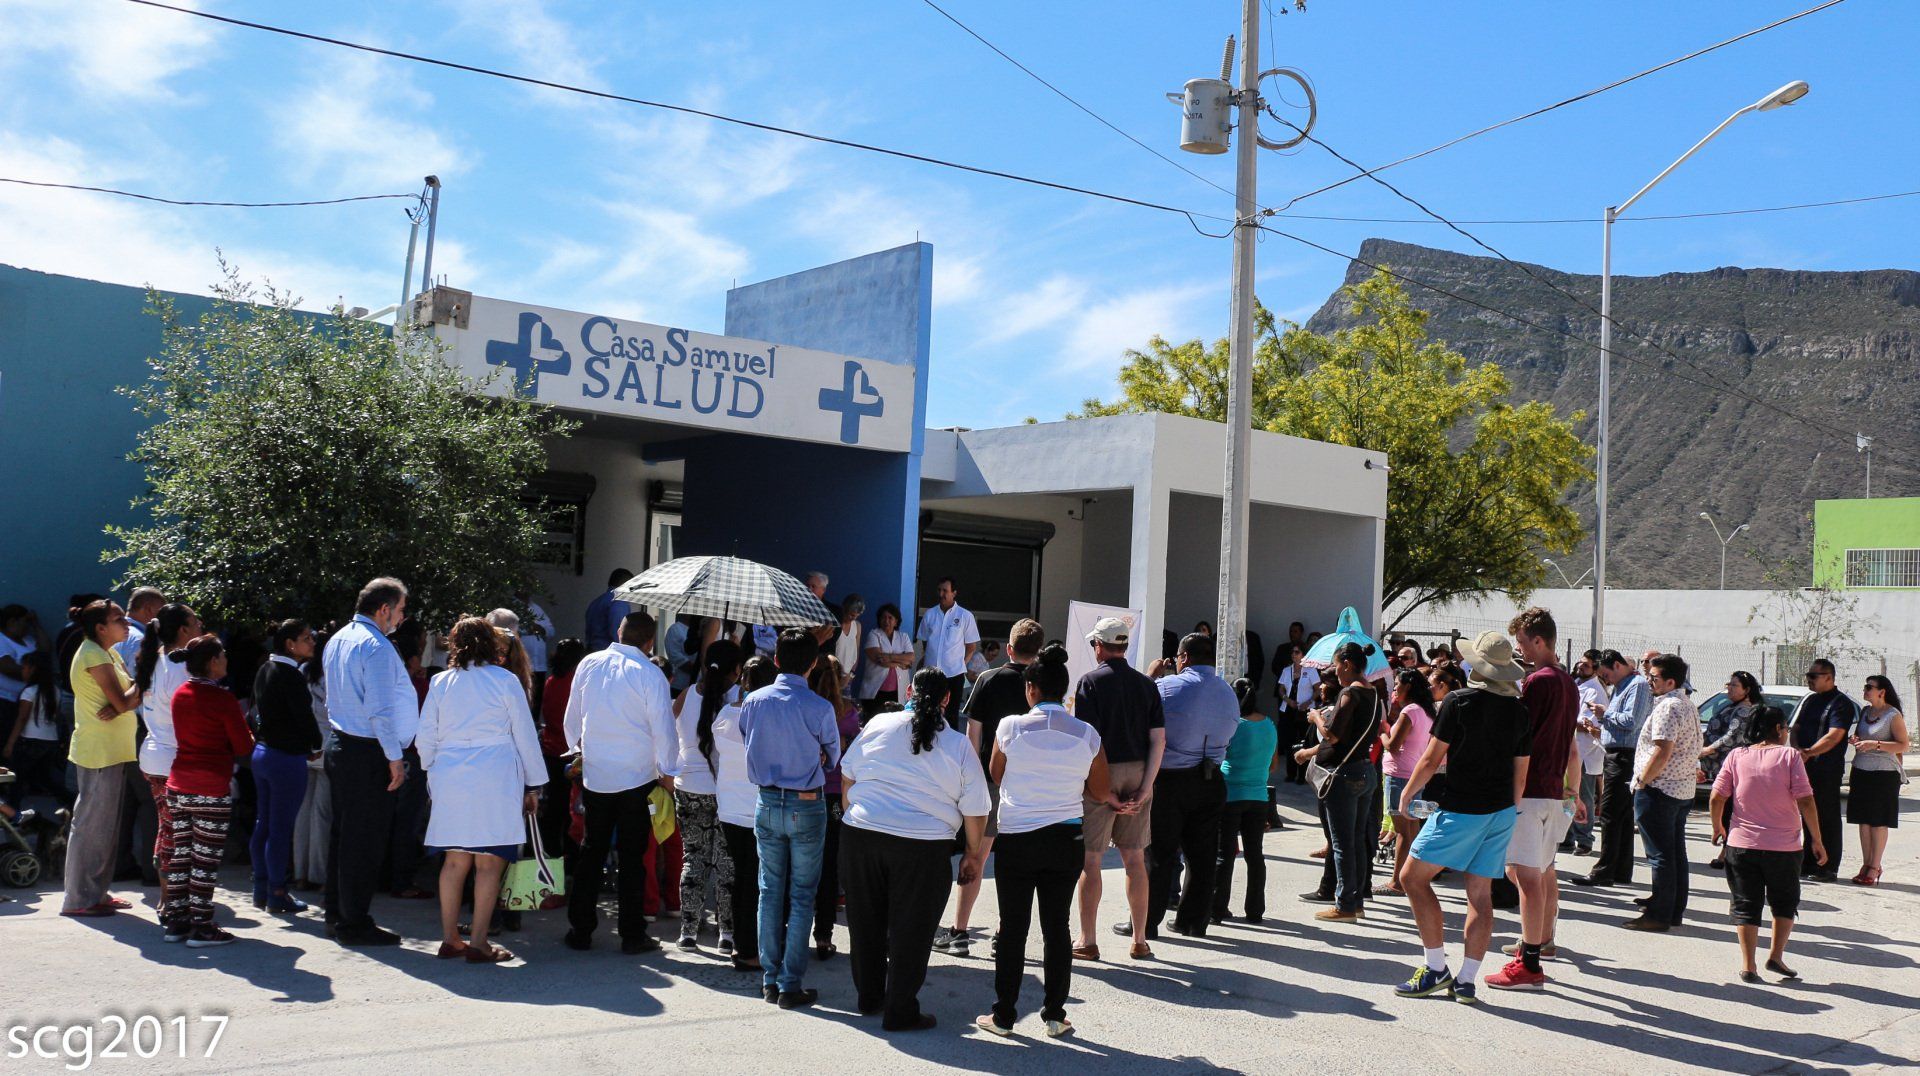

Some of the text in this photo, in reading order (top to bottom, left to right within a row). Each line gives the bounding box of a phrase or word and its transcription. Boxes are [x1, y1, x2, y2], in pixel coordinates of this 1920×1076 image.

[581, 316, 775, 379] Casa Samuel
[582, 356, 765, 418] SALUD
